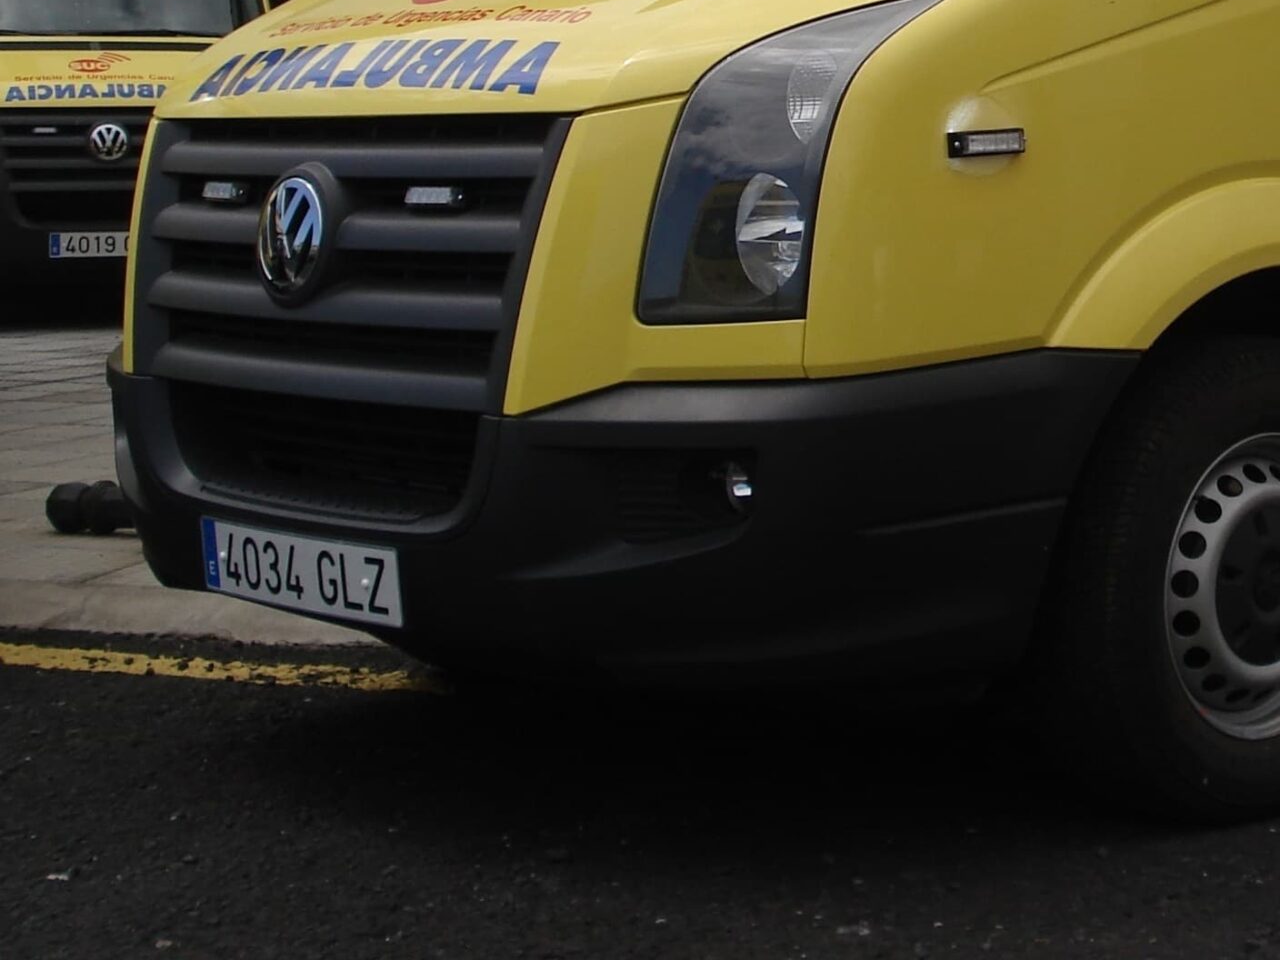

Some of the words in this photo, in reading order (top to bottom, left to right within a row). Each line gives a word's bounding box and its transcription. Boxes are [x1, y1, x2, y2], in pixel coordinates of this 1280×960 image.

[382, 6, 494, 28] Urgencias
[495, 4, 595, 25] Canario
[70, 61, 110, 72] SUC
[65, 235, 116, 254] 4019
[226, 532, 304, 600] 4034
[317, 550, 389, 615] GLZ
